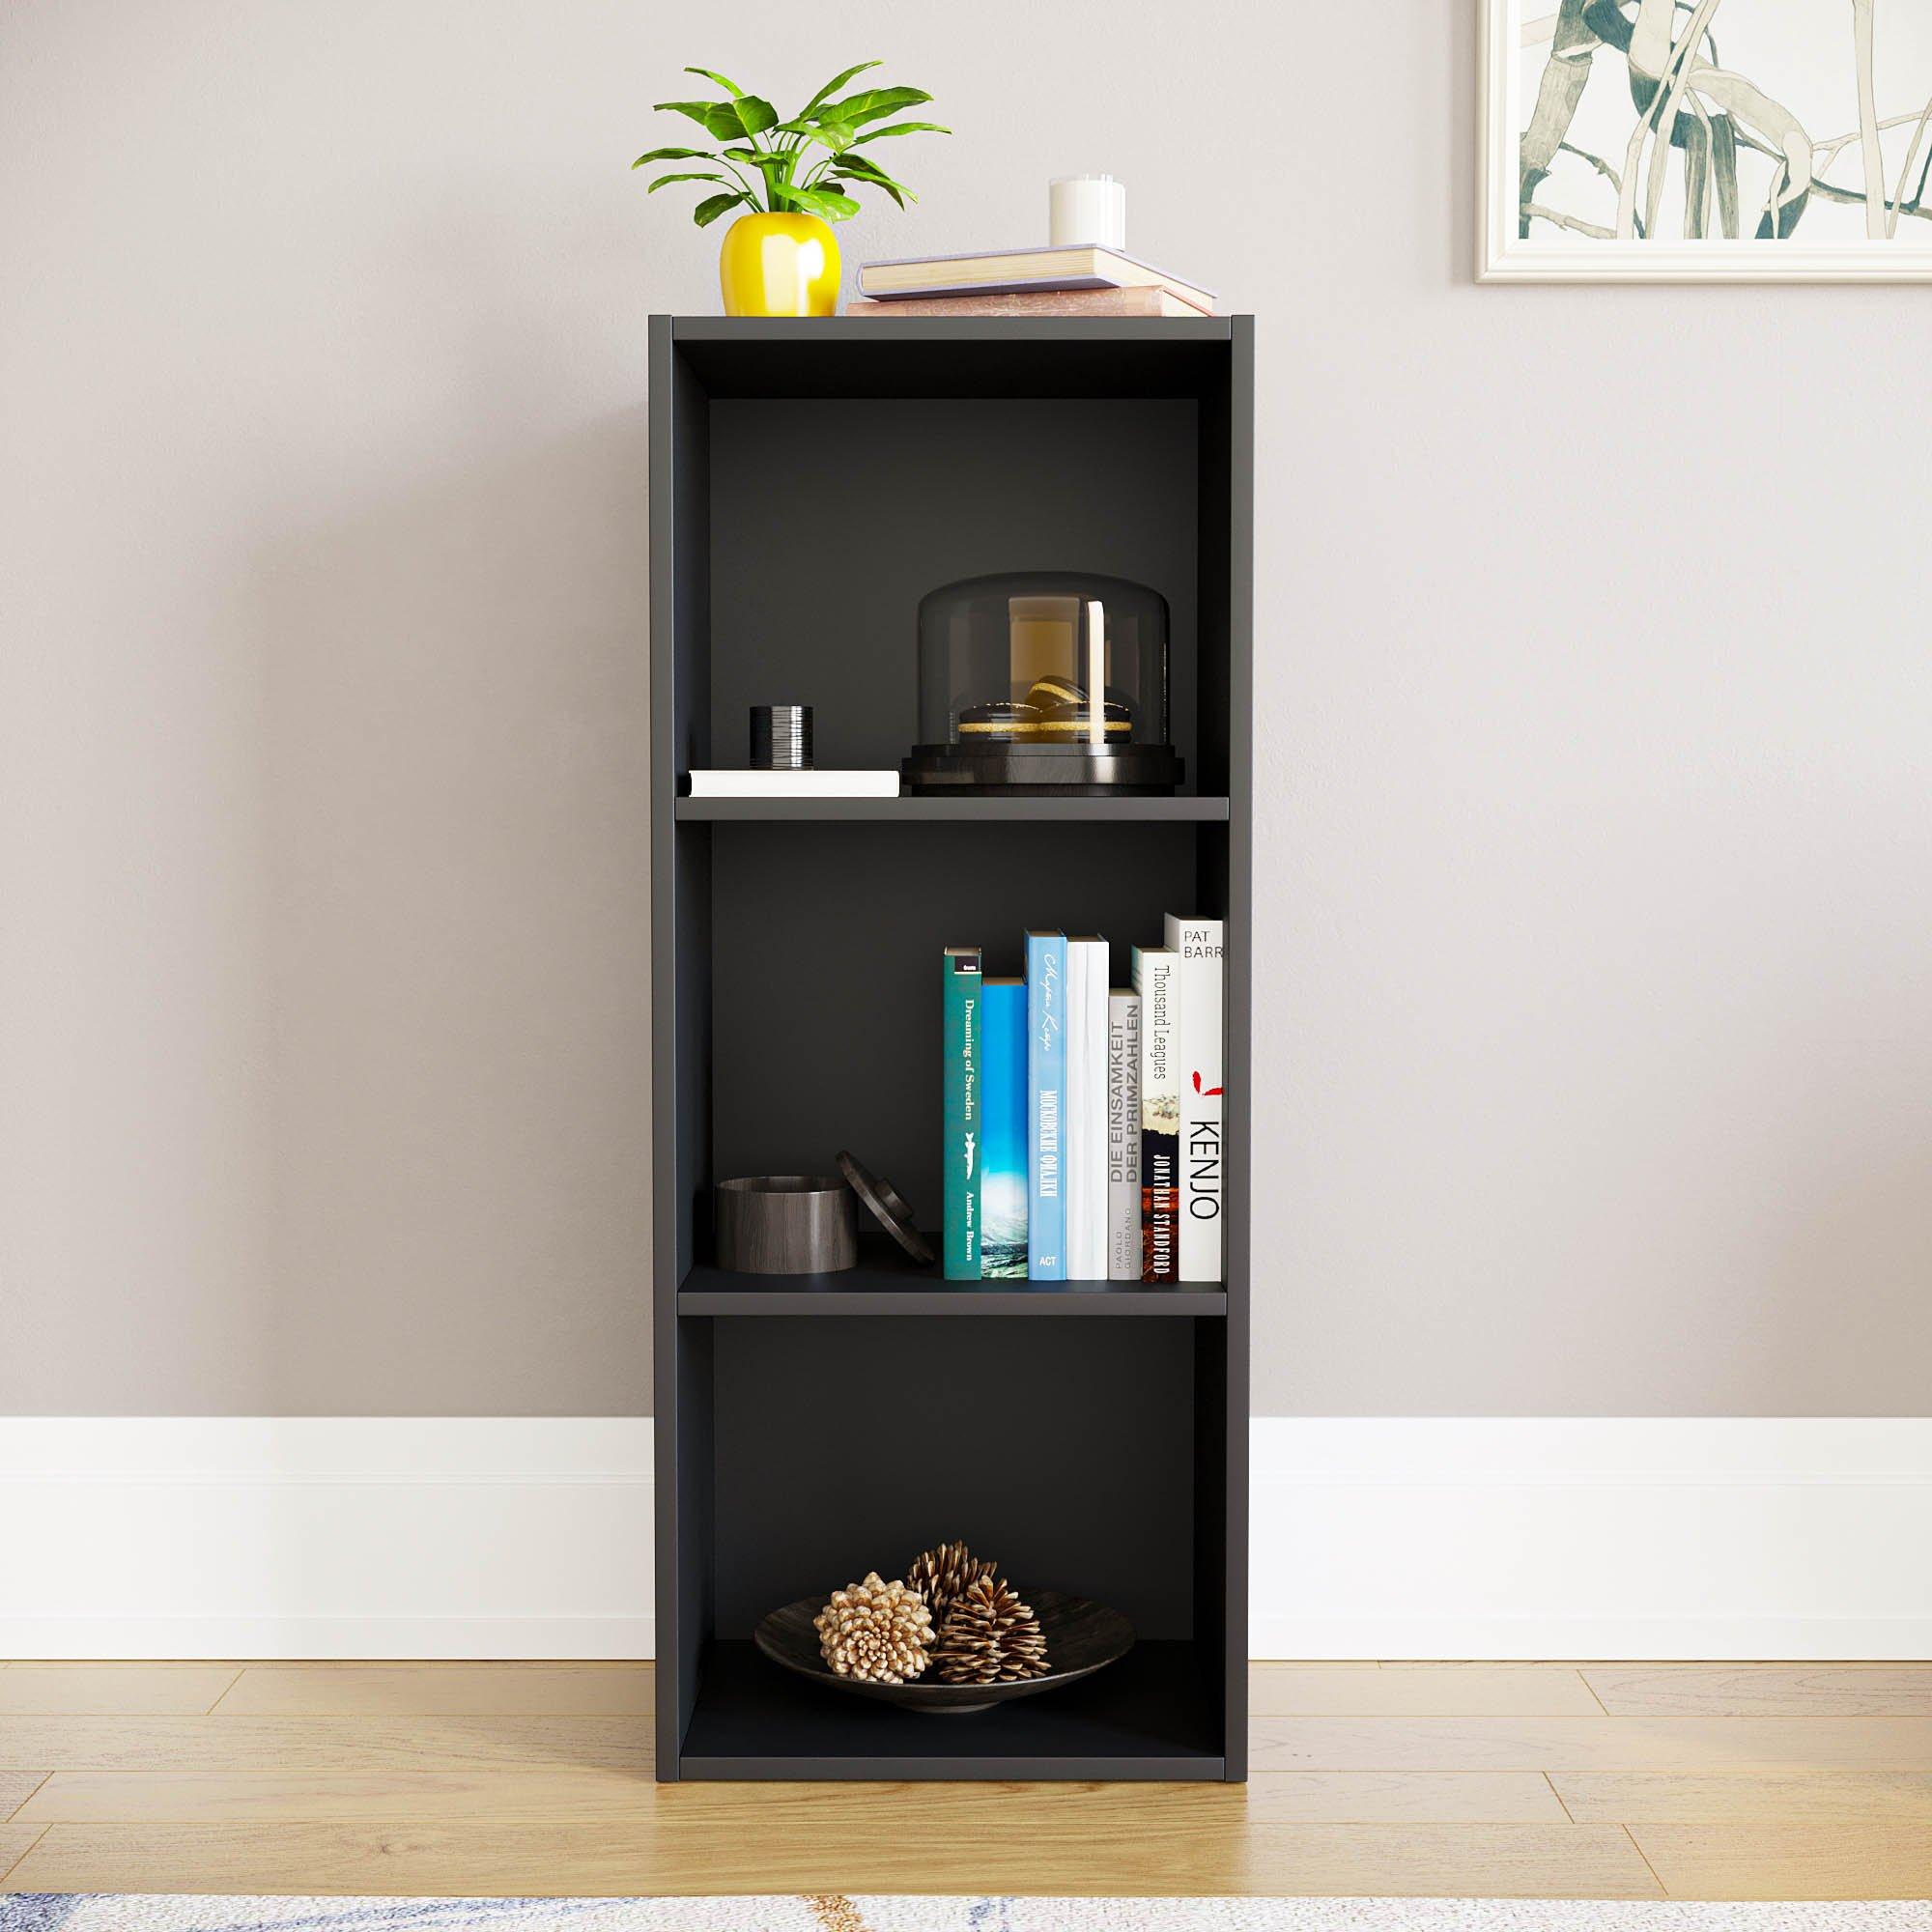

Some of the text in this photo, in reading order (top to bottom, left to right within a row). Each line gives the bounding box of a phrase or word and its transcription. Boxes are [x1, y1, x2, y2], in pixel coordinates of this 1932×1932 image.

[1184, 930, 1210, 943] PAT
[963, 999, 975, 1121] Dreaming of Sweden
[1151, 965, 1171, 1080] Thousand Leagues
[1039, 1090, 1058, 1198] МОСКОВСКИЕ ФИАЛКИ
[1111, 1021, 1123, 1183] DIE EINSAMKEIT
[1126, 1005, 1138, 1183] DER PRIMZAHLEN
[965, 1191, 975, 1262] Andrew Brown
[1153, 1154, 1171, 1274] JONATHAN STANDFORD
[1189, 1121, 1220, 1220] KENJO
